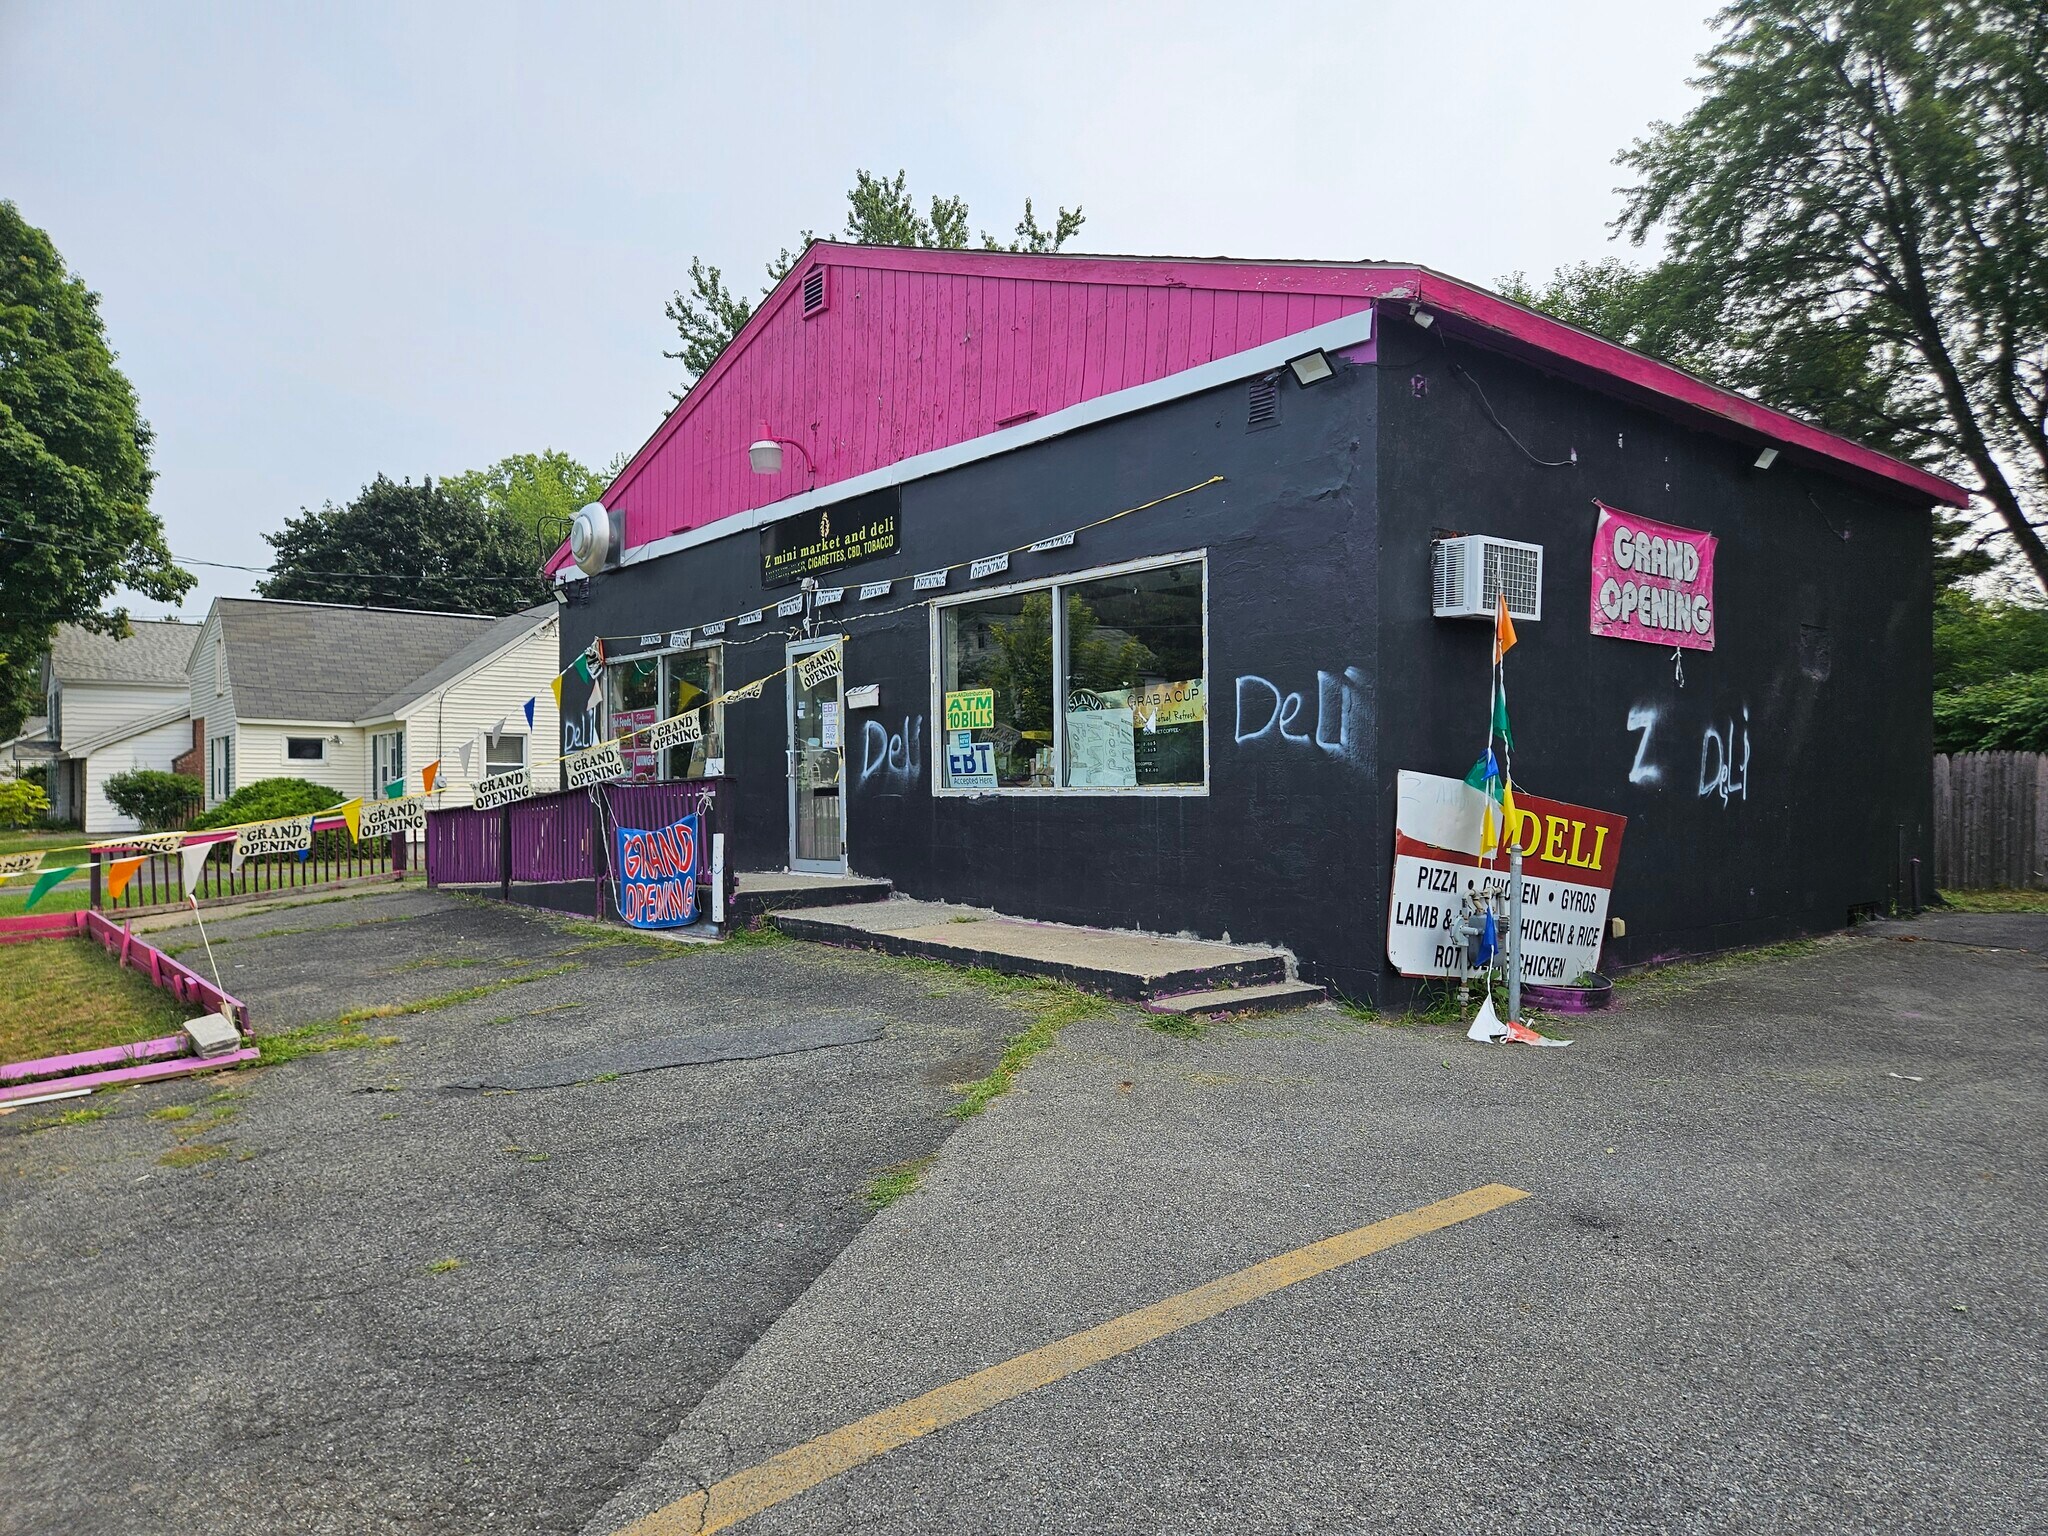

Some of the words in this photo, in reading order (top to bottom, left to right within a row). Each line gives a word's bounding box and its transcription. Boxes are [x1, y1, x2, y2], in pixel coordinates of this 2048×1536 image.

[765, 555, 771, 568] Z
[774, 546, 797, 566] mini
[800, 535, 840, 557] market
[844, 526, 866, 545] and
[870, 516, 894, 536] deli
[808, 549, 847, 570] CIGARETTES,
[864, 535, 894, 554] TOBACCO
[1613, 526, 1700, 583] GRAND
[1599, 577, 1712, 635] OPENING
[804, 649, 836, 673] GRAND
[948, 696, 992, 712] ATM
[1127, 693, 1160, 707] GRAB
[1164, 693, 1172, 704] A
[1174, 688, 1199, 702] CUP
[657, 717, 693, 737] GRAND
[962, 710, 993, 728] BILLS
[653, 728, 700, 750] OPENING
[1626, 705, 1661, 783] Z
[573, 750, 615, 772] GRAND
[950, 745, 991, 774] EBT
[479, 772, 524, 793] GRAND
[571, 763, 622, 786] OPENING
[953, 777, 979, 786] Accepted
[979, 776, 993, 784] Here
[475, 786, 530, 809] OPENING
[369, 803, 417, 824] GRAND
[247, 825, 301, 842] GRAND
[362, 815, 424, 837] OPENING
[239, 838, 308, 856] OPENING
[1506, 808, 1609, 871] DELI
[624, 824, 694, 880] GRAND
[626, 876, 694, 922] OPENING
[1417, 866, 1458, 893] PIZZA
[1561, 889, 1597, 913] GYROS
[1396, 902, 1438, 929] LAMB
[1442, 908, 1452, 930] &
[1520, 919, 1564, 943] HICKEN
[1567, 930, 1575, 944] &
[1576, 926, 1600, 947] RICE
